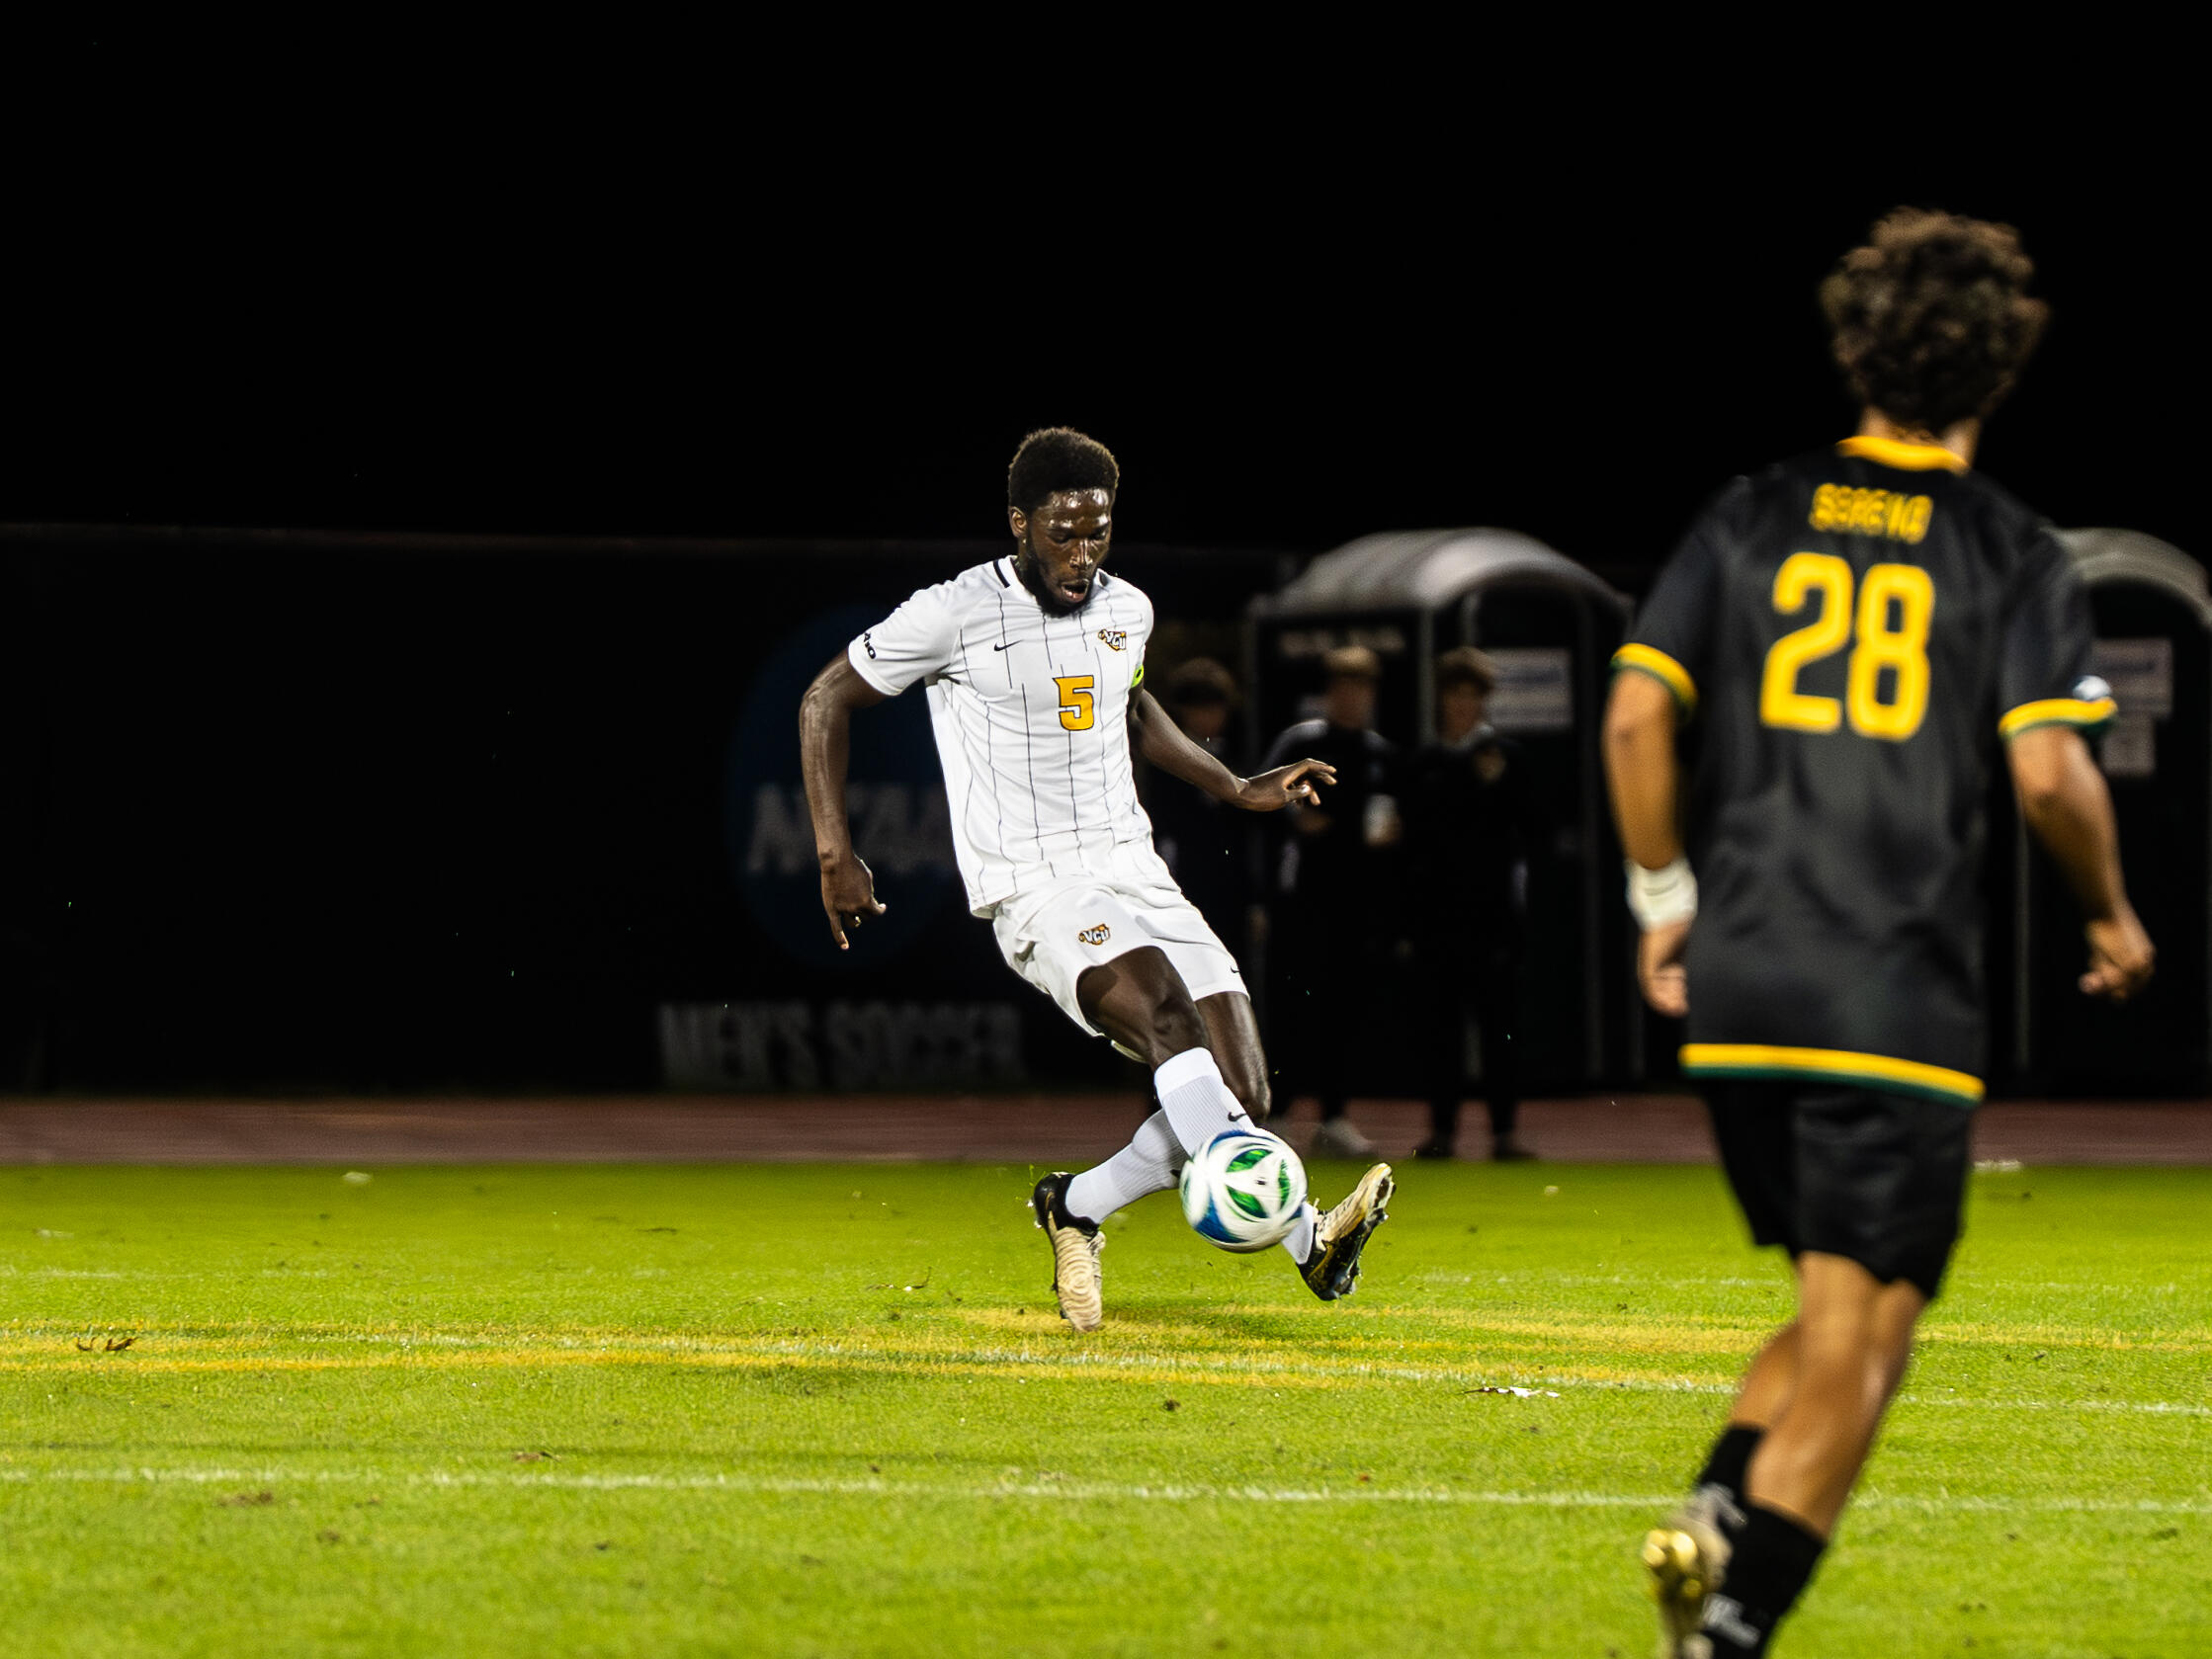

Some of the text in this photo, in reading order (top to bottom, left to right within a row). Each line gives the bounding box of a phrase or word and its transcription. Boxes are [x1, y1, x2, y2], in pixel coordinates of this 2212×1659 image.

[1099, 629, 1127, 650] VCU
[1760, 551, 1934, 741] 28
[1053, 675, 1095, 731] 5
[745, 781, 957, 874] NAA
[1079, 924, 1111, 946] VCU
